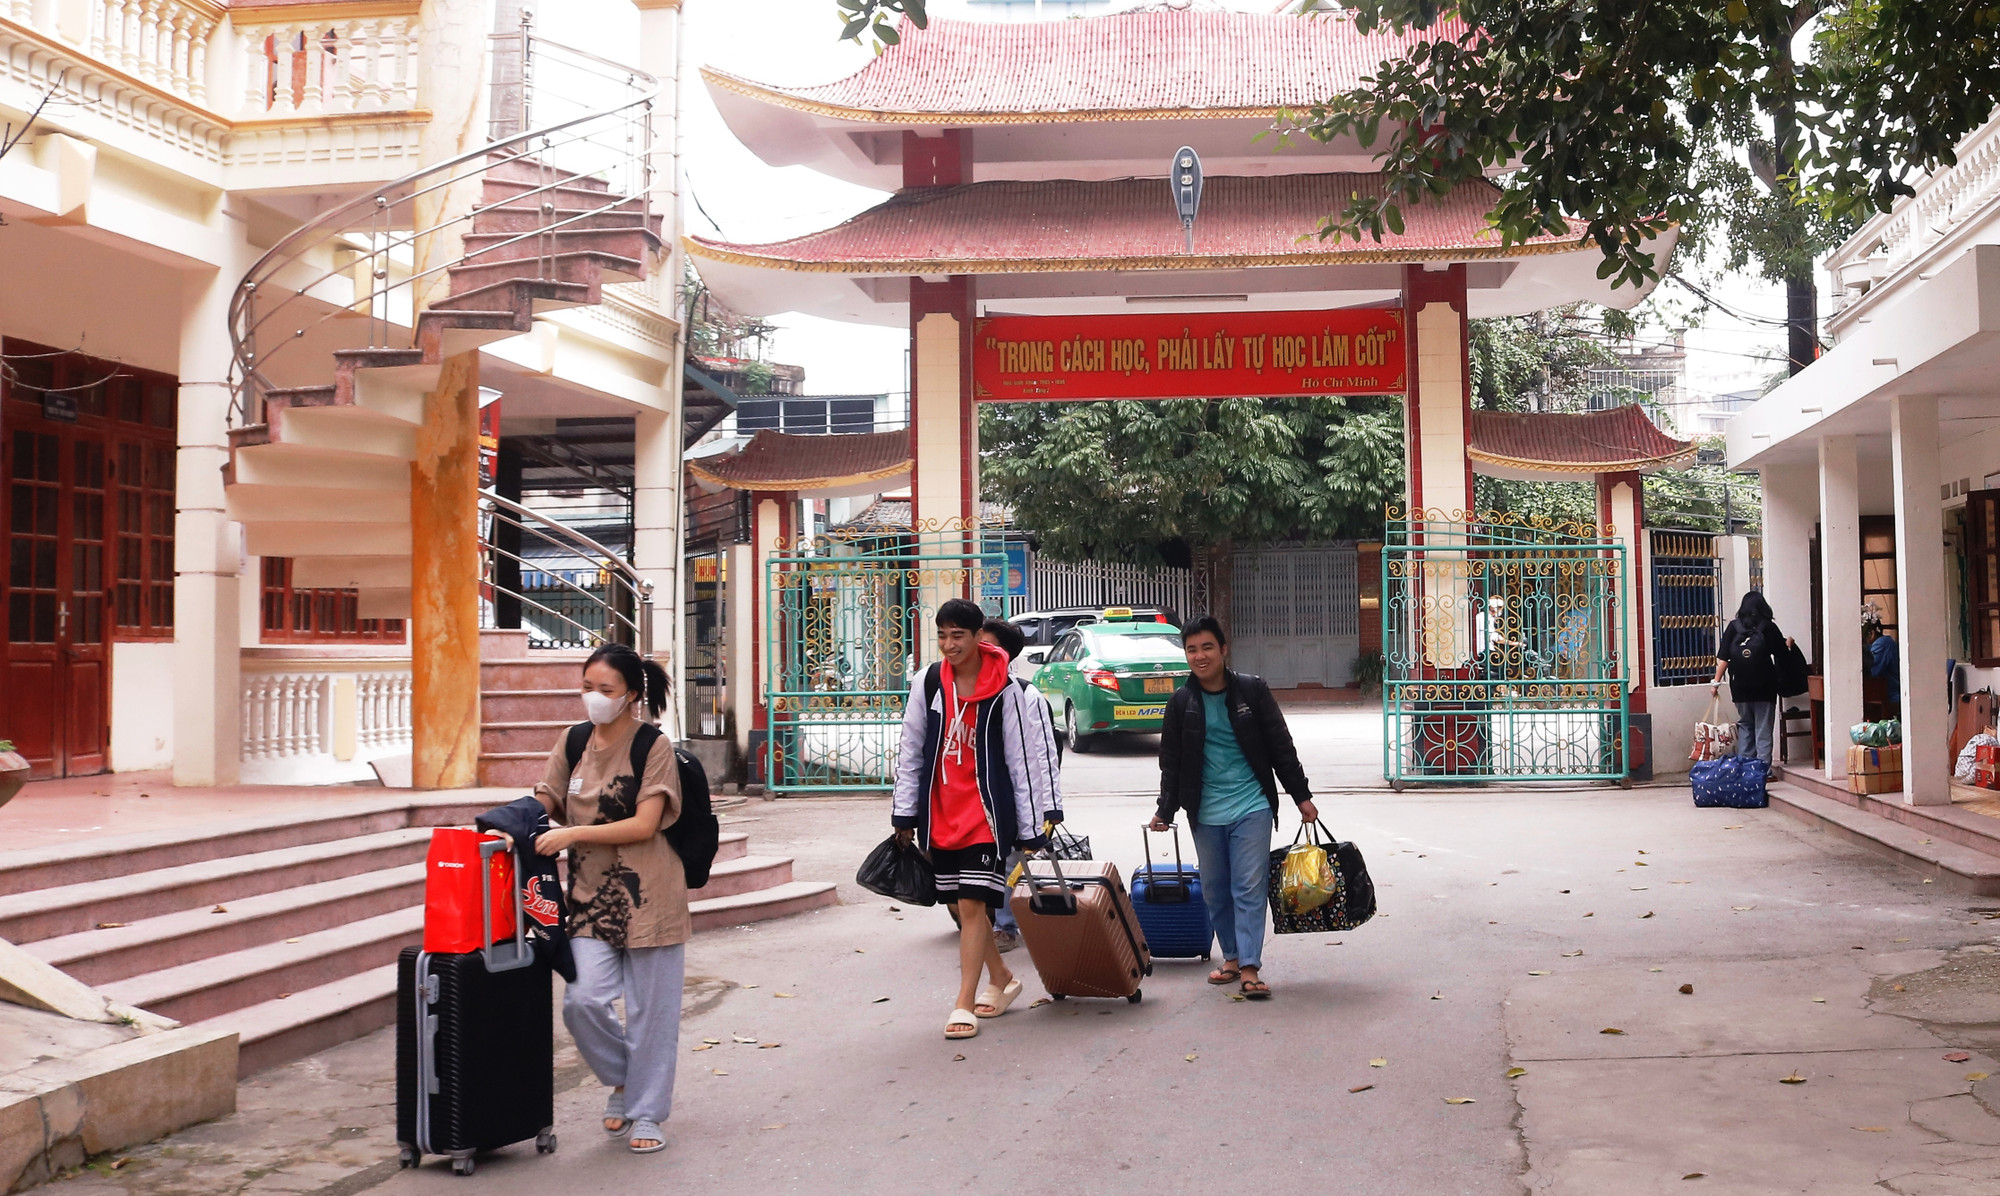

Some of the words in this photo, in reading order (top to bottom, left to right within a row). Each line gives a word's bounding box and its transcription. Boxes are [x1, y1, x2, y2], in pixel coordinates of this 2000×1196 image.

[1060, 334, 1105, 372] CÁCH
[1111, 338, 1150, 377] HỌC,
[1157, 327, 1198, 370] PHẢI
[1203, 329, 1235, 370] LẤY
[1242, 333, 1266, 375] TỰ
[1272, 334, 1306, 374] HỌC
[1347, 375, 1378, 387] Minh
